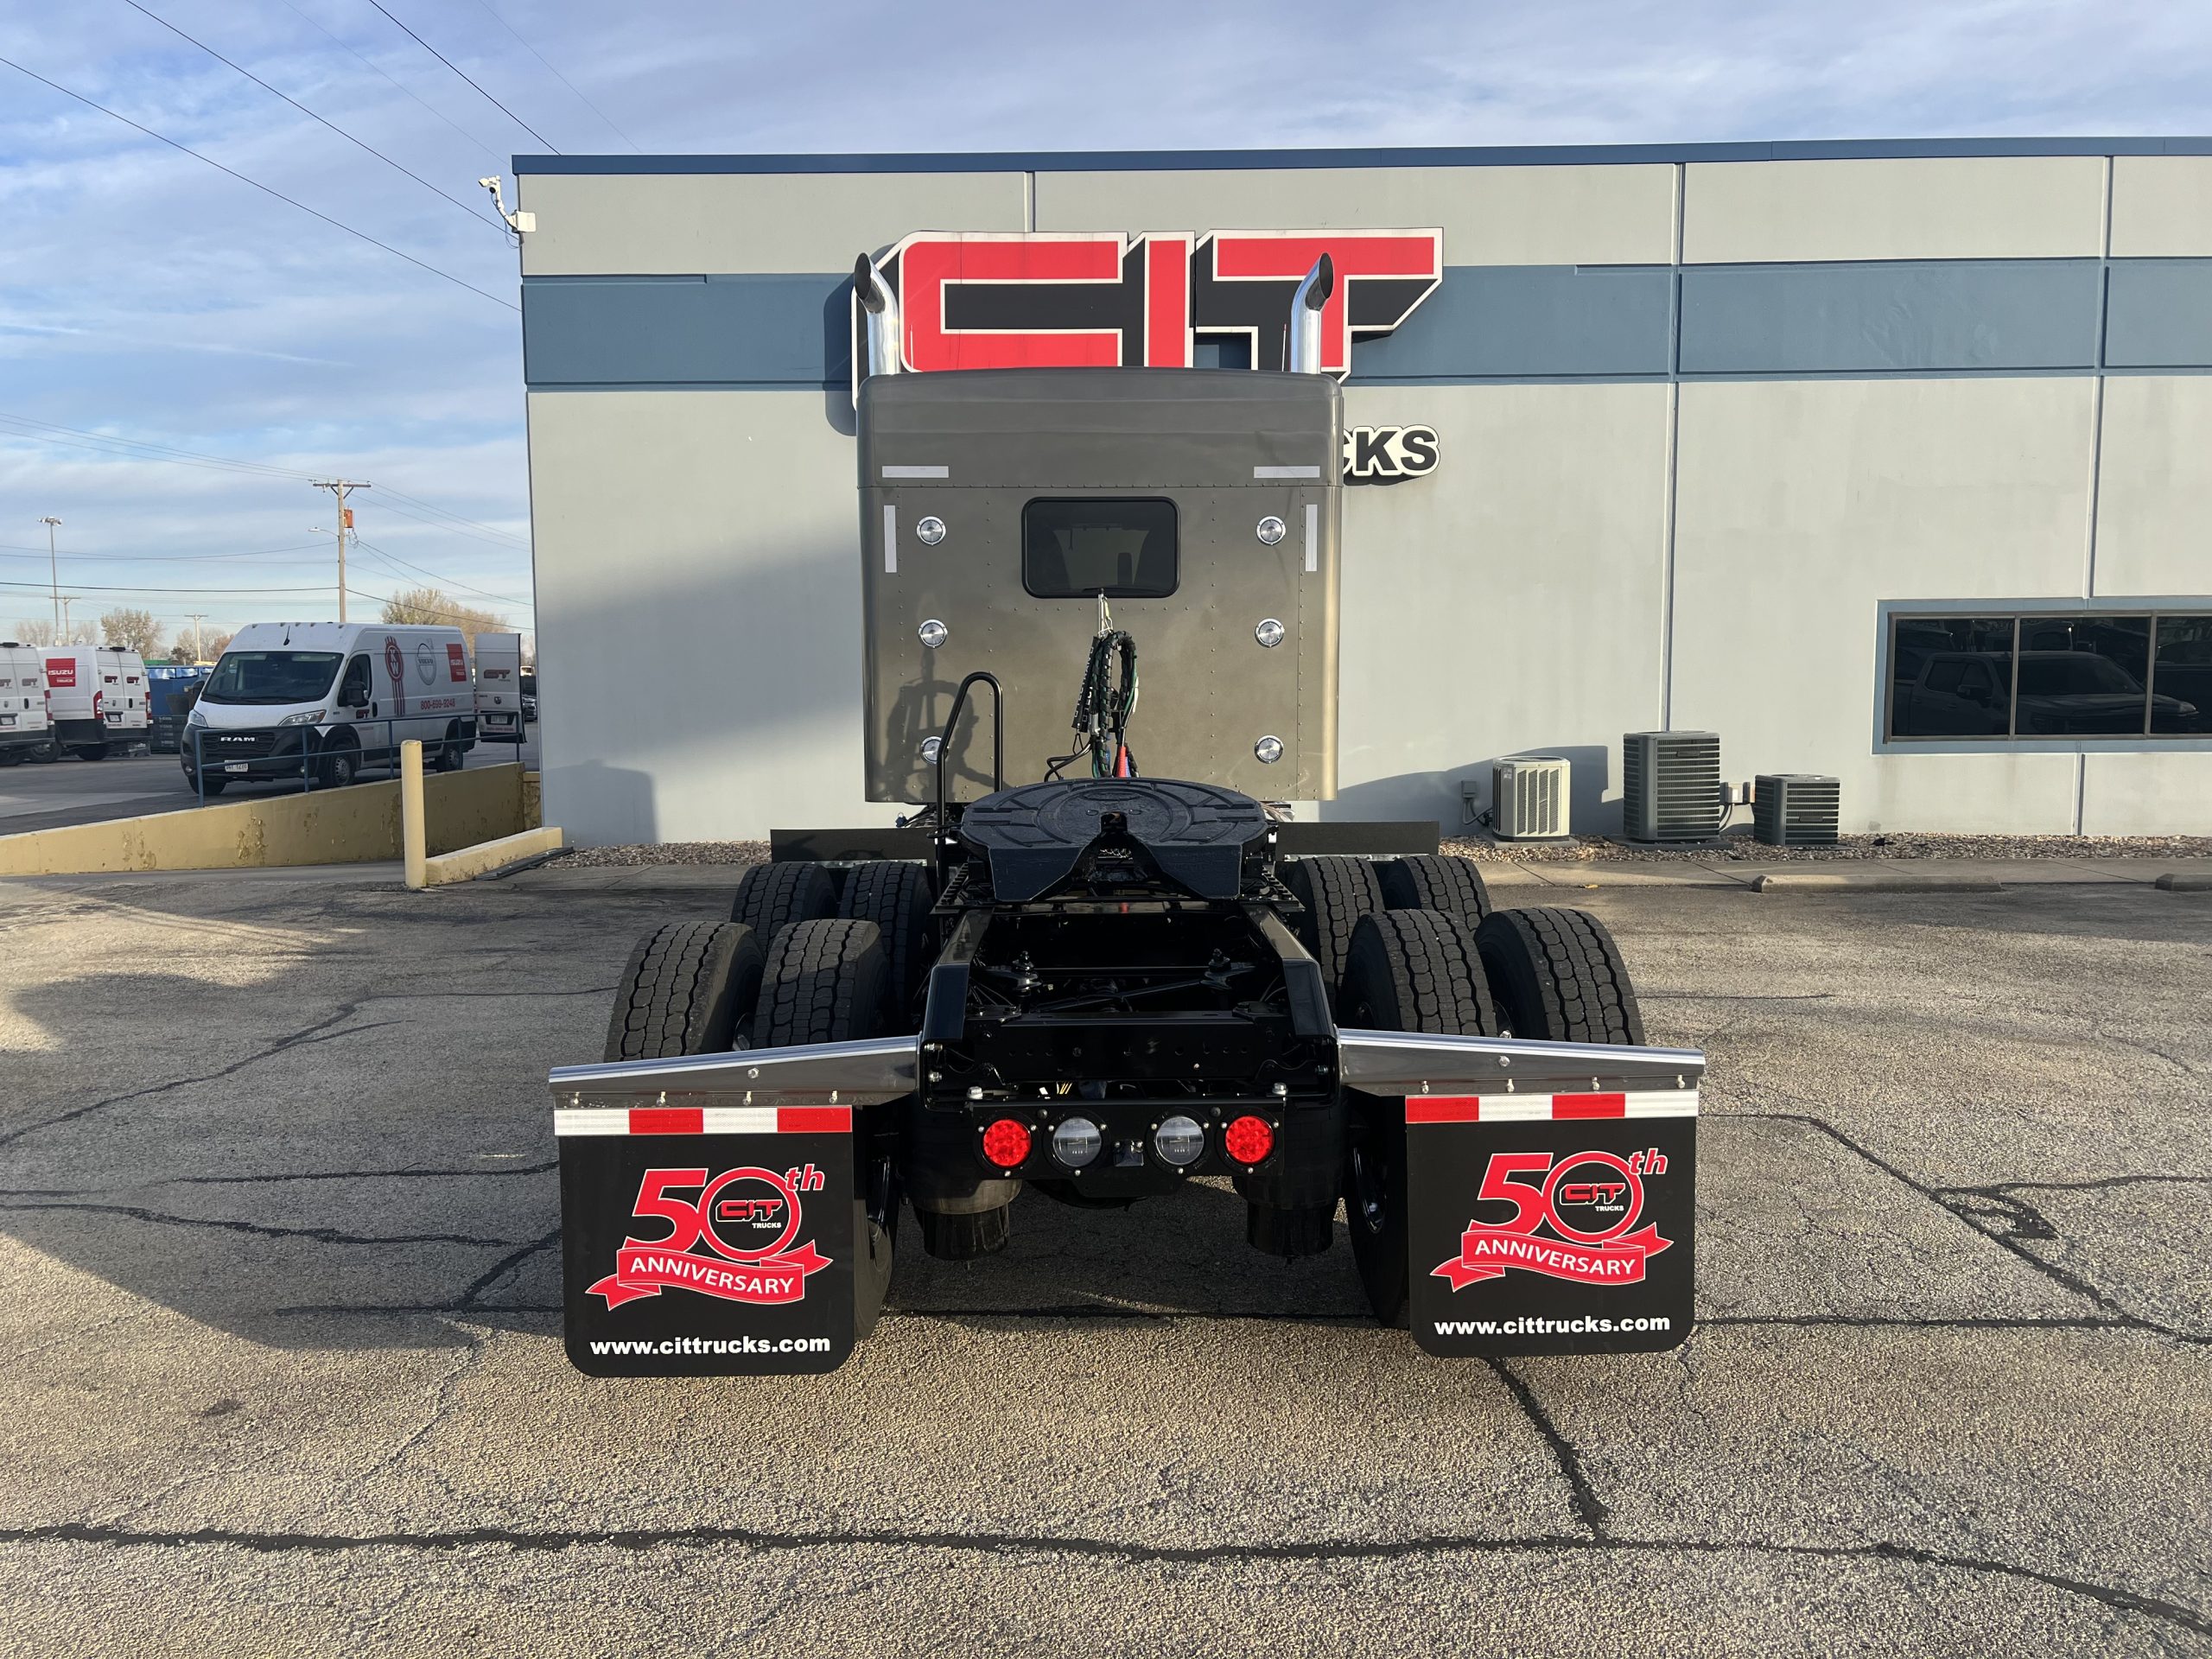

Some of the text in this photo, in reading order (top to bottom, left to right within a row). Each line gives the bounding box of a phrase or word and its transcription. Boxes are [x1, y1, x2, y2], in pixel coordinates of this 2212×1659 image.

[854, 228, 1443, 378] CIT
[1343, 429, 1437, 472] KS
[1559, 1182, 1626, 1205] CIT
[715, 1199, 783, 1223] CIT
[1474, 1238, 1636, 1276] ANNIVERSARY
[630, 1255, 794, 1294] ANNIVERSARY
[1433, 1315, 1671, 1335] www.cittrucks.com
[589, 1335, 830, 1355] www.cittrucks.com
